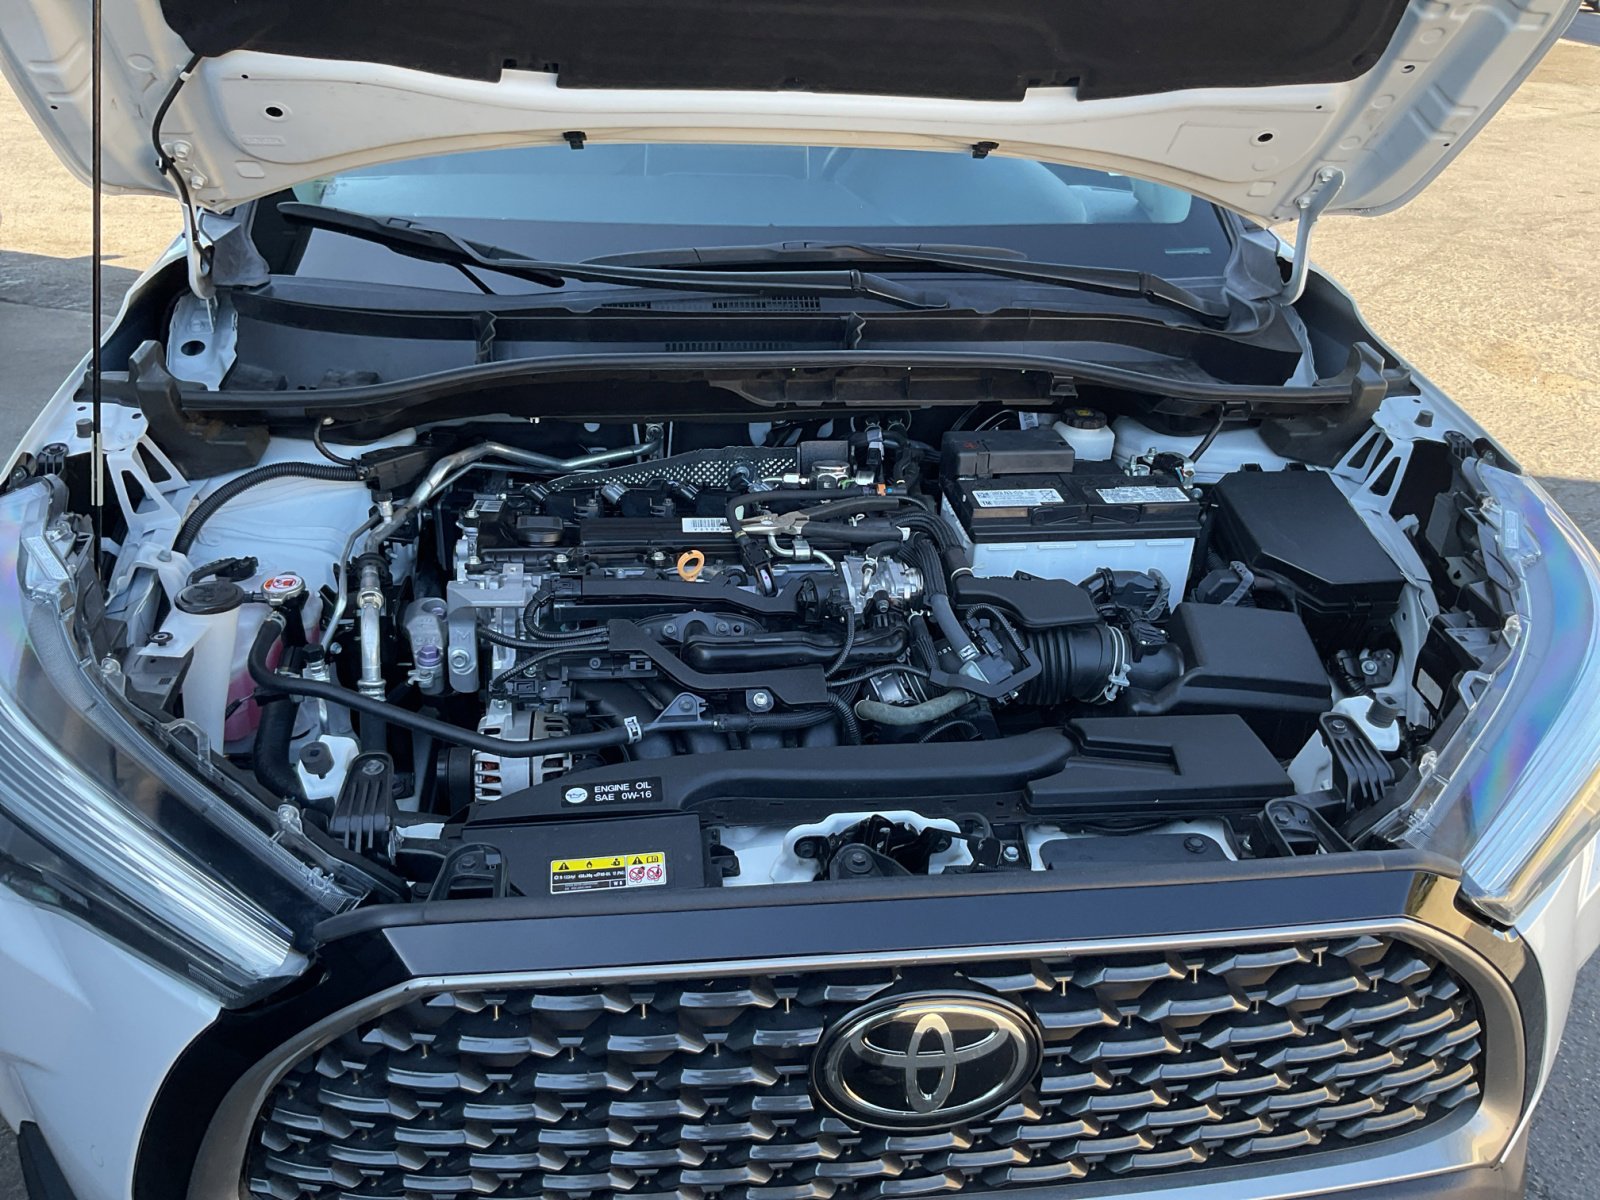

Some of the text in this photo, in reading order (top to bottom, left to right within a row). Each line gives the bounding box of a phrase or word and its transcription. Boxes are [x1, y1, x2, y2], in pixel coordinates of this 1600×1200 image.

[594, 781, 652, 793] ENGINE OIL
[594, 790, 652, 802] SAE 0W-16
